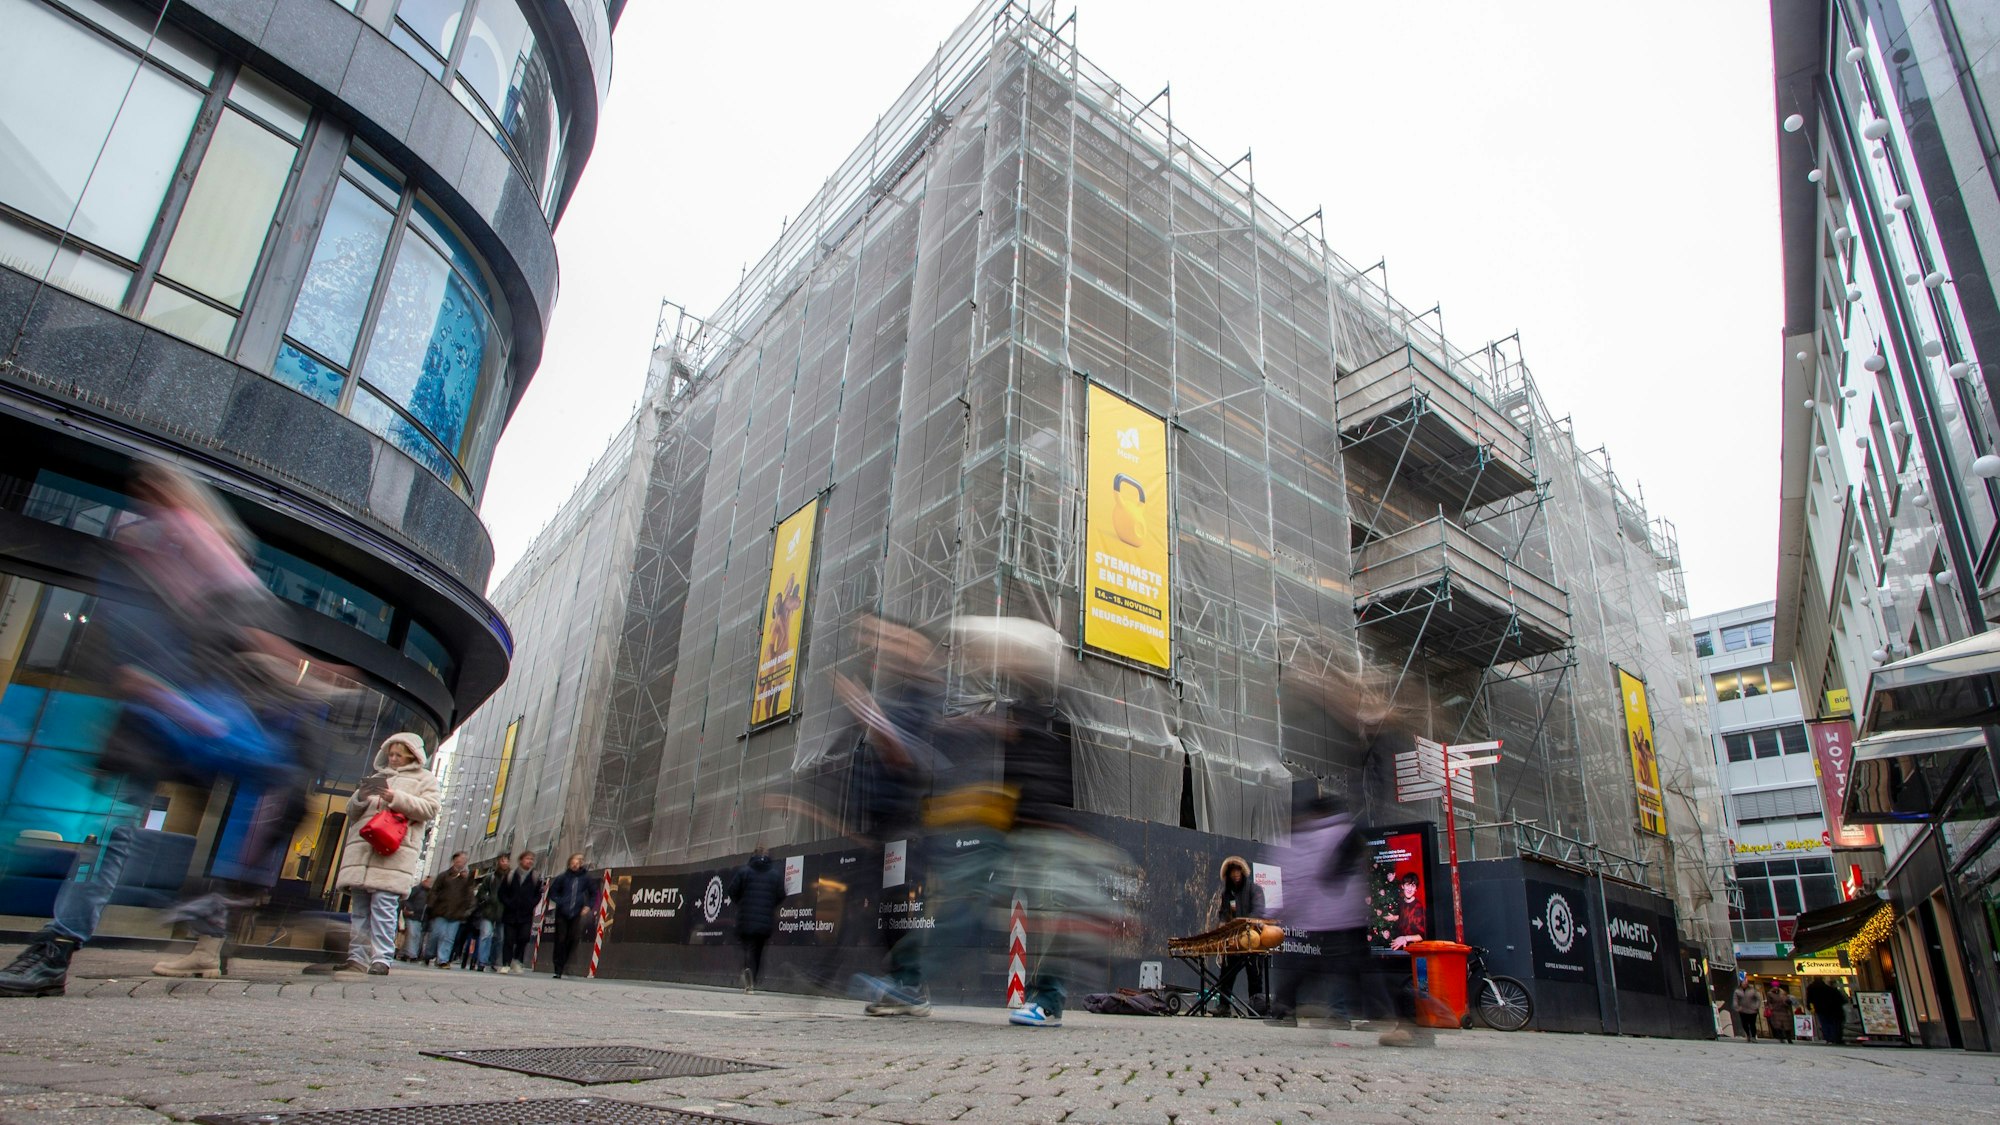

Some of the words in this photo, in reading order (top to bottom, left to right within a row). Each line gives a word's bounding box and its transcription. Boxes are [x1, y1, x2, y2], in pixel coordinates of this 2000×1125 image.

[1036, 241, 1058, 258] TOKUS
[1206, 533, 1224, 547] TOKUS
[1095, 551, 1162, 586] STEMMSTE
[1099, 567, 1124, 587] ENE
[1127, 577, 1159, 600] MET?
[1124, 599, 1160, 618] NOVEMBER
[1091, 606, 1164, 639] NEUERÖFFNUNG
[643, 887, 679, 904] McFIT
[630, 908, 675, 917] NEUERÖFFNUNG
[780, 907, 799, 919] Coming
[799, 908, 813, 917] soon:
[893, 901, 908, 913] auch
[778, 921, 798, 933] Cologne
[799, 920, 815, 931] Public
[815, 921, 834, 933] Library
[888, 916, 935, 930] Stadtbibliothek
[1618, 919, 1649, 943] McFIT
[1612, 943, 1653, 961] NEUERÖFFNUNG
